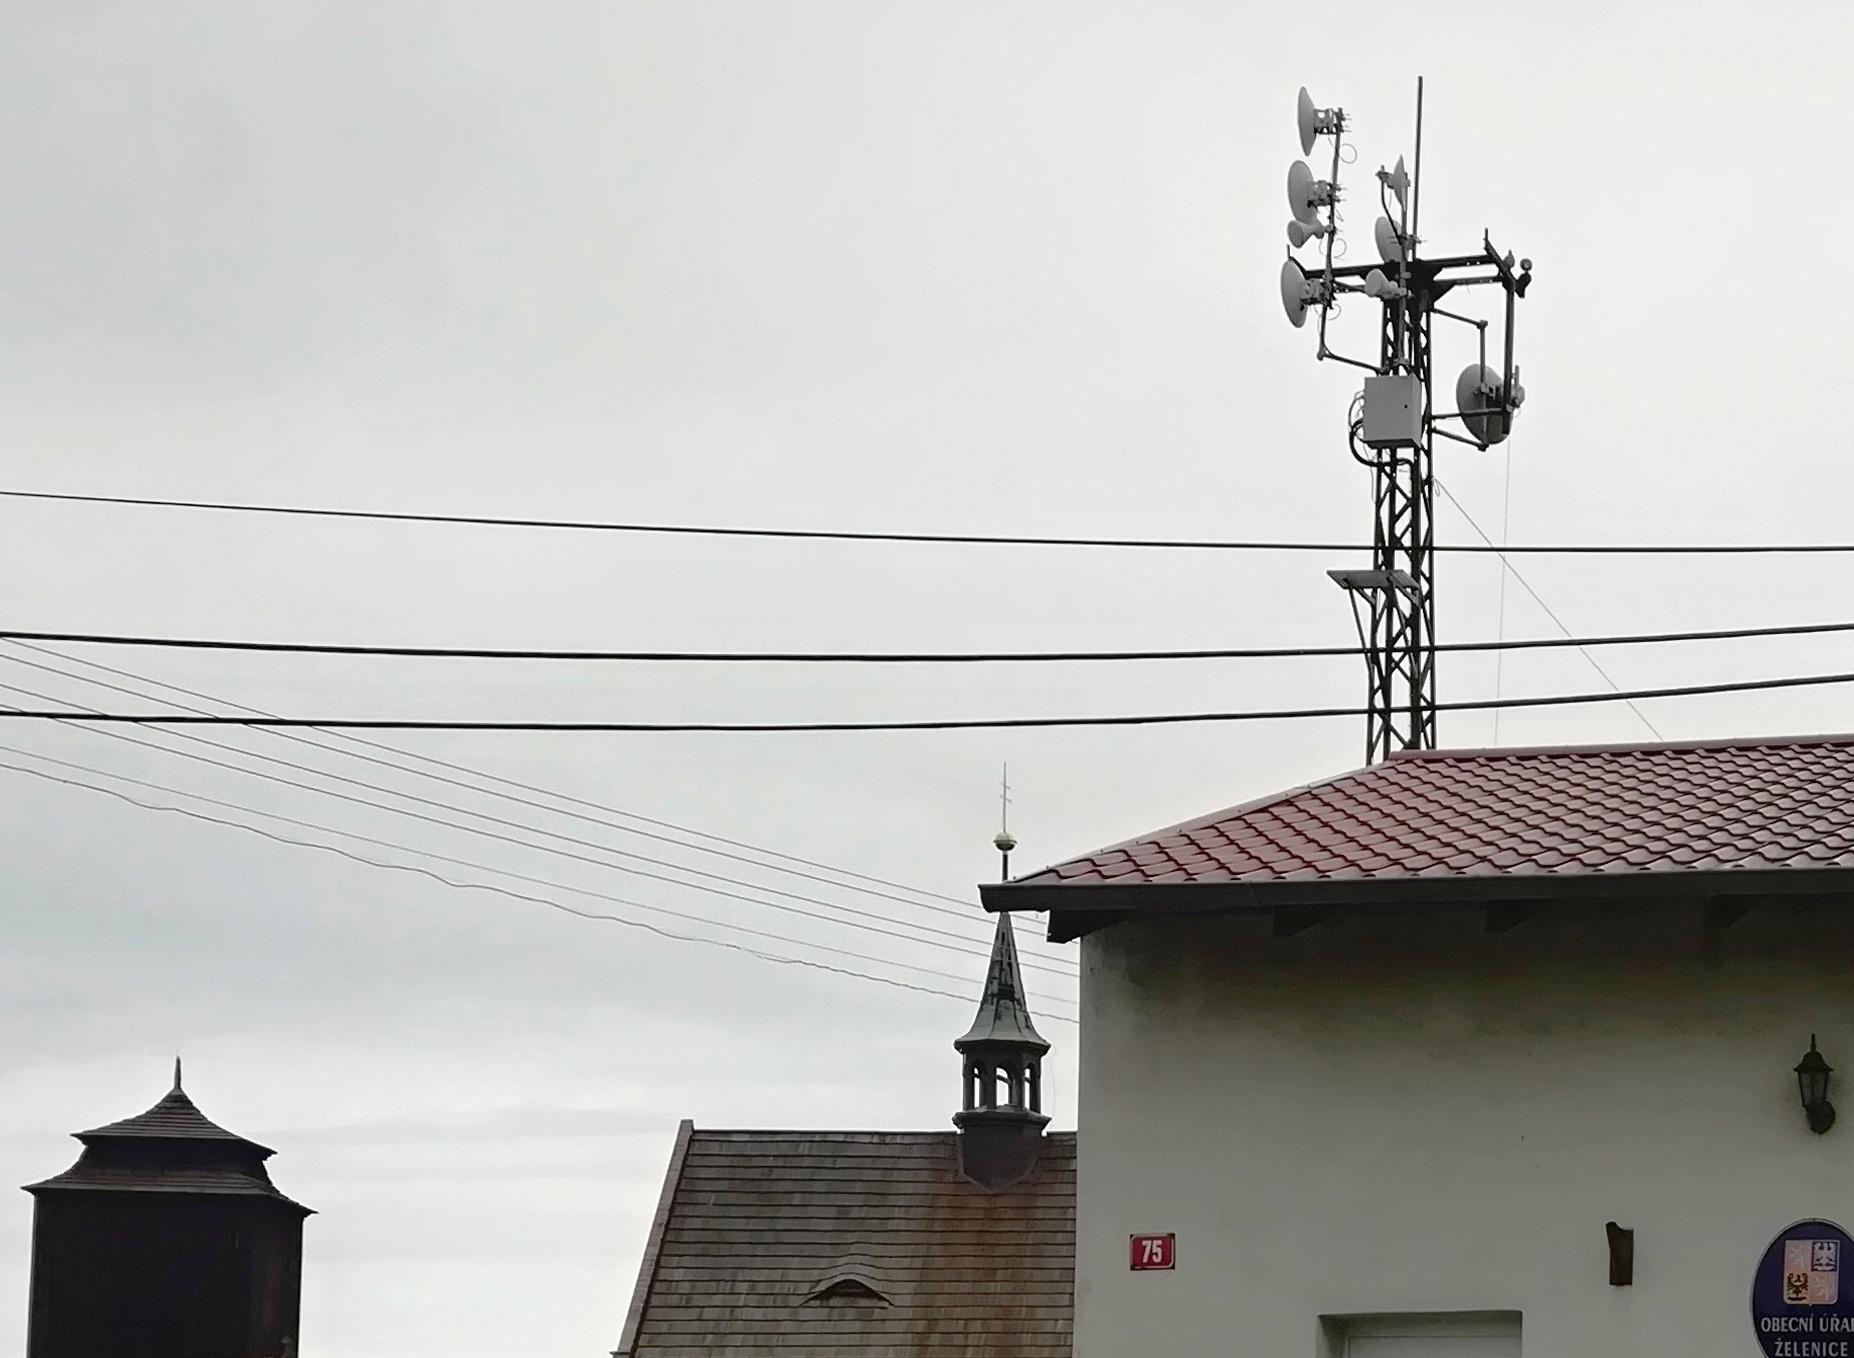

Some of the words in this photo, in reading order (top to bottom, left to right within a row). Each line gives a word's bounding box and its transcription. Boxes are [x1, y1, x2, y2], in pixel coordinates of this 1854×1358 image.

[1142, 1240, 1162, 1263] 75
[1761, 1313, 1814, 1332] OBECNÍ
[1774, 1338, 1848, 1357] ŽELENICE
